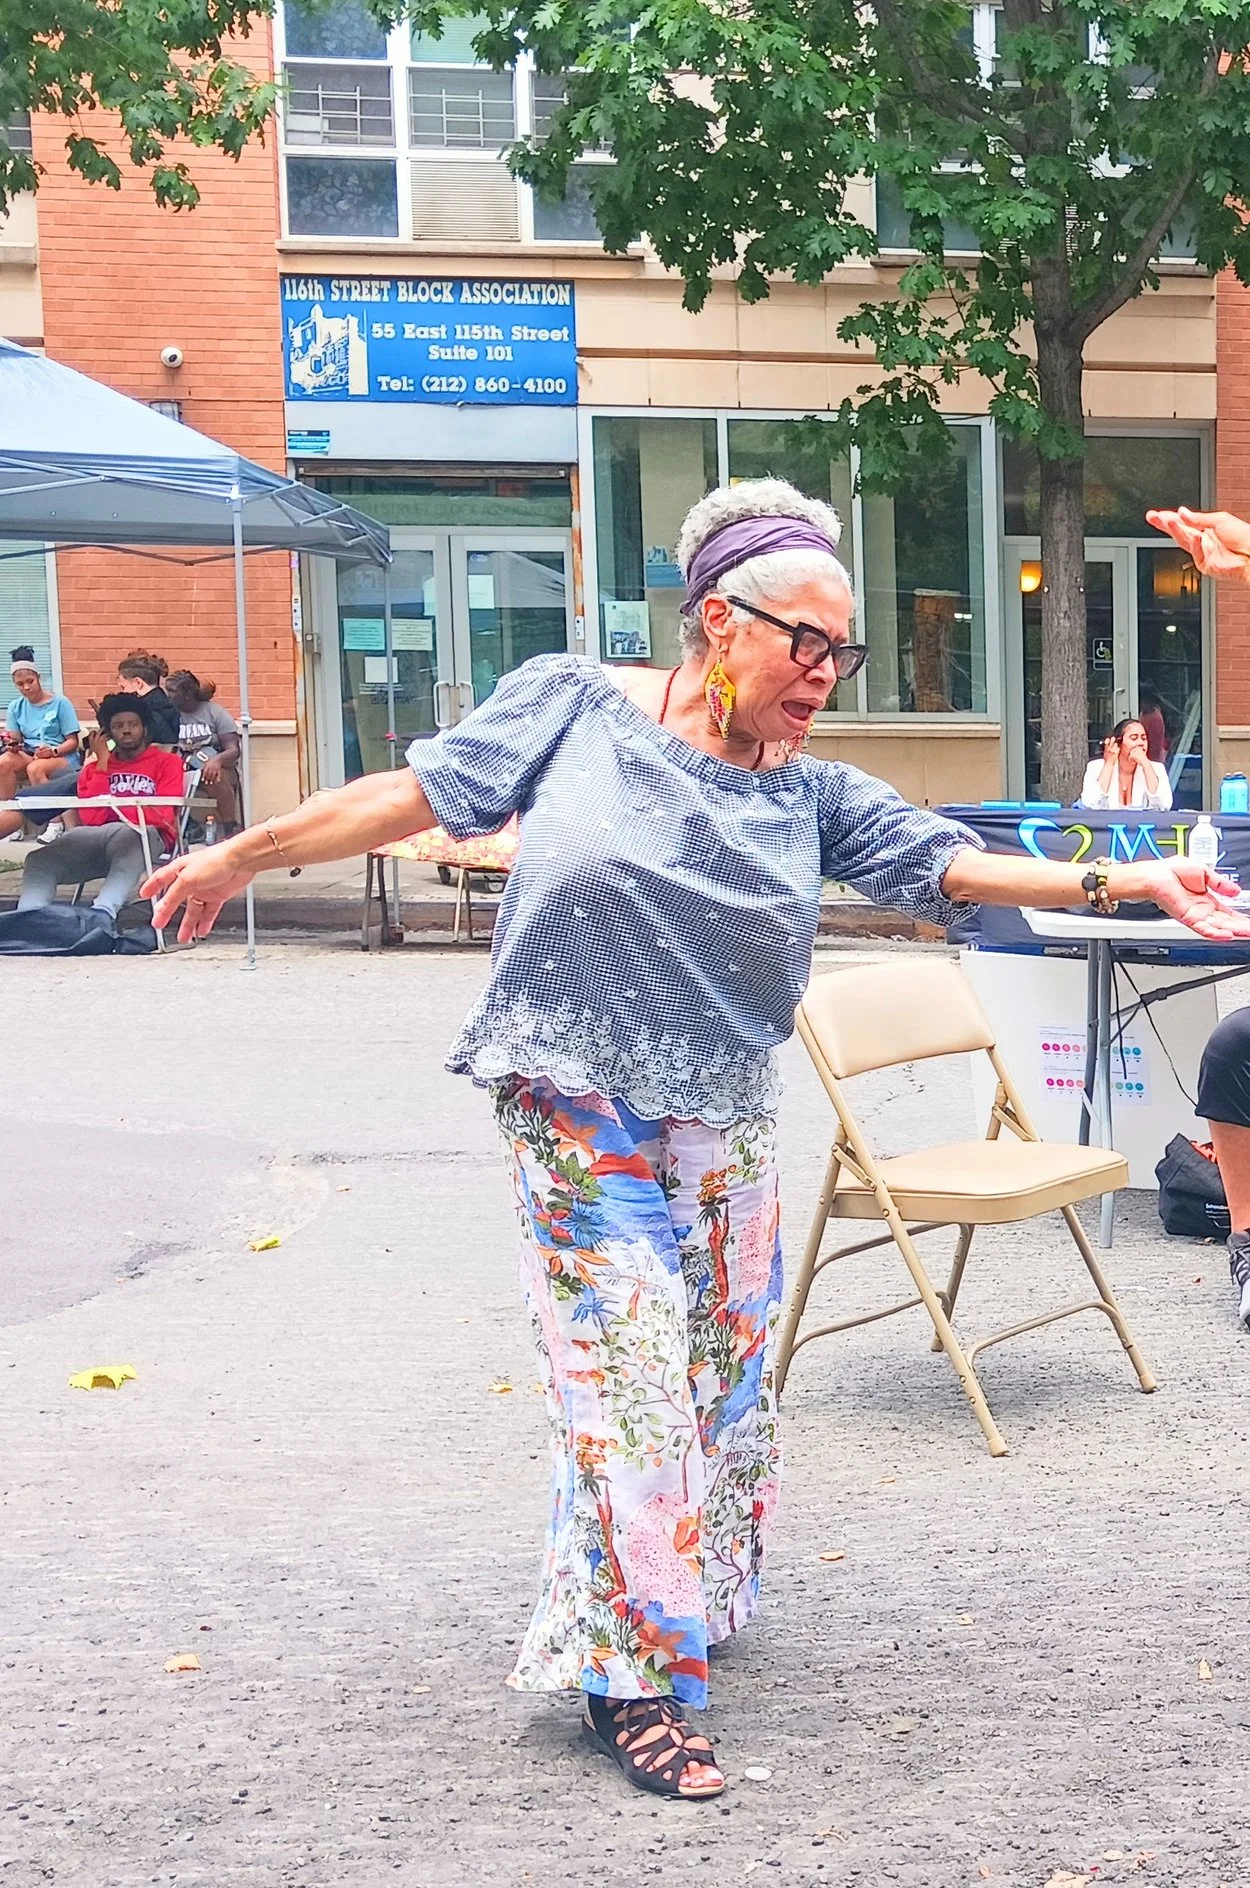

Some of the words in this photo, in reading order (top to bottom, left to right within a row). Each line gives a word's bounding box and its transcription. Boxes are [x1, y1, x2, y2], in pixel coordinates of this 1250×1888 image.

[284, 278, 325, 301] 116th
[330, 279, 391, 302] STREET
[397, 281, 454, 303] BLOCK
[459, 282, 571, 306] ASSOCIATION
[371, 323, 396, 339] 55
[403, 323, 447, 340] East
[455, 324, 504, 341] 115th
[511, 326, 570, 342] Street
[428, 345, 479, 360] Suite
[486, 345, 514, 361] 101
[377, 375, 415, 392] Tel:
[421, 375, 467, 393] (212)
